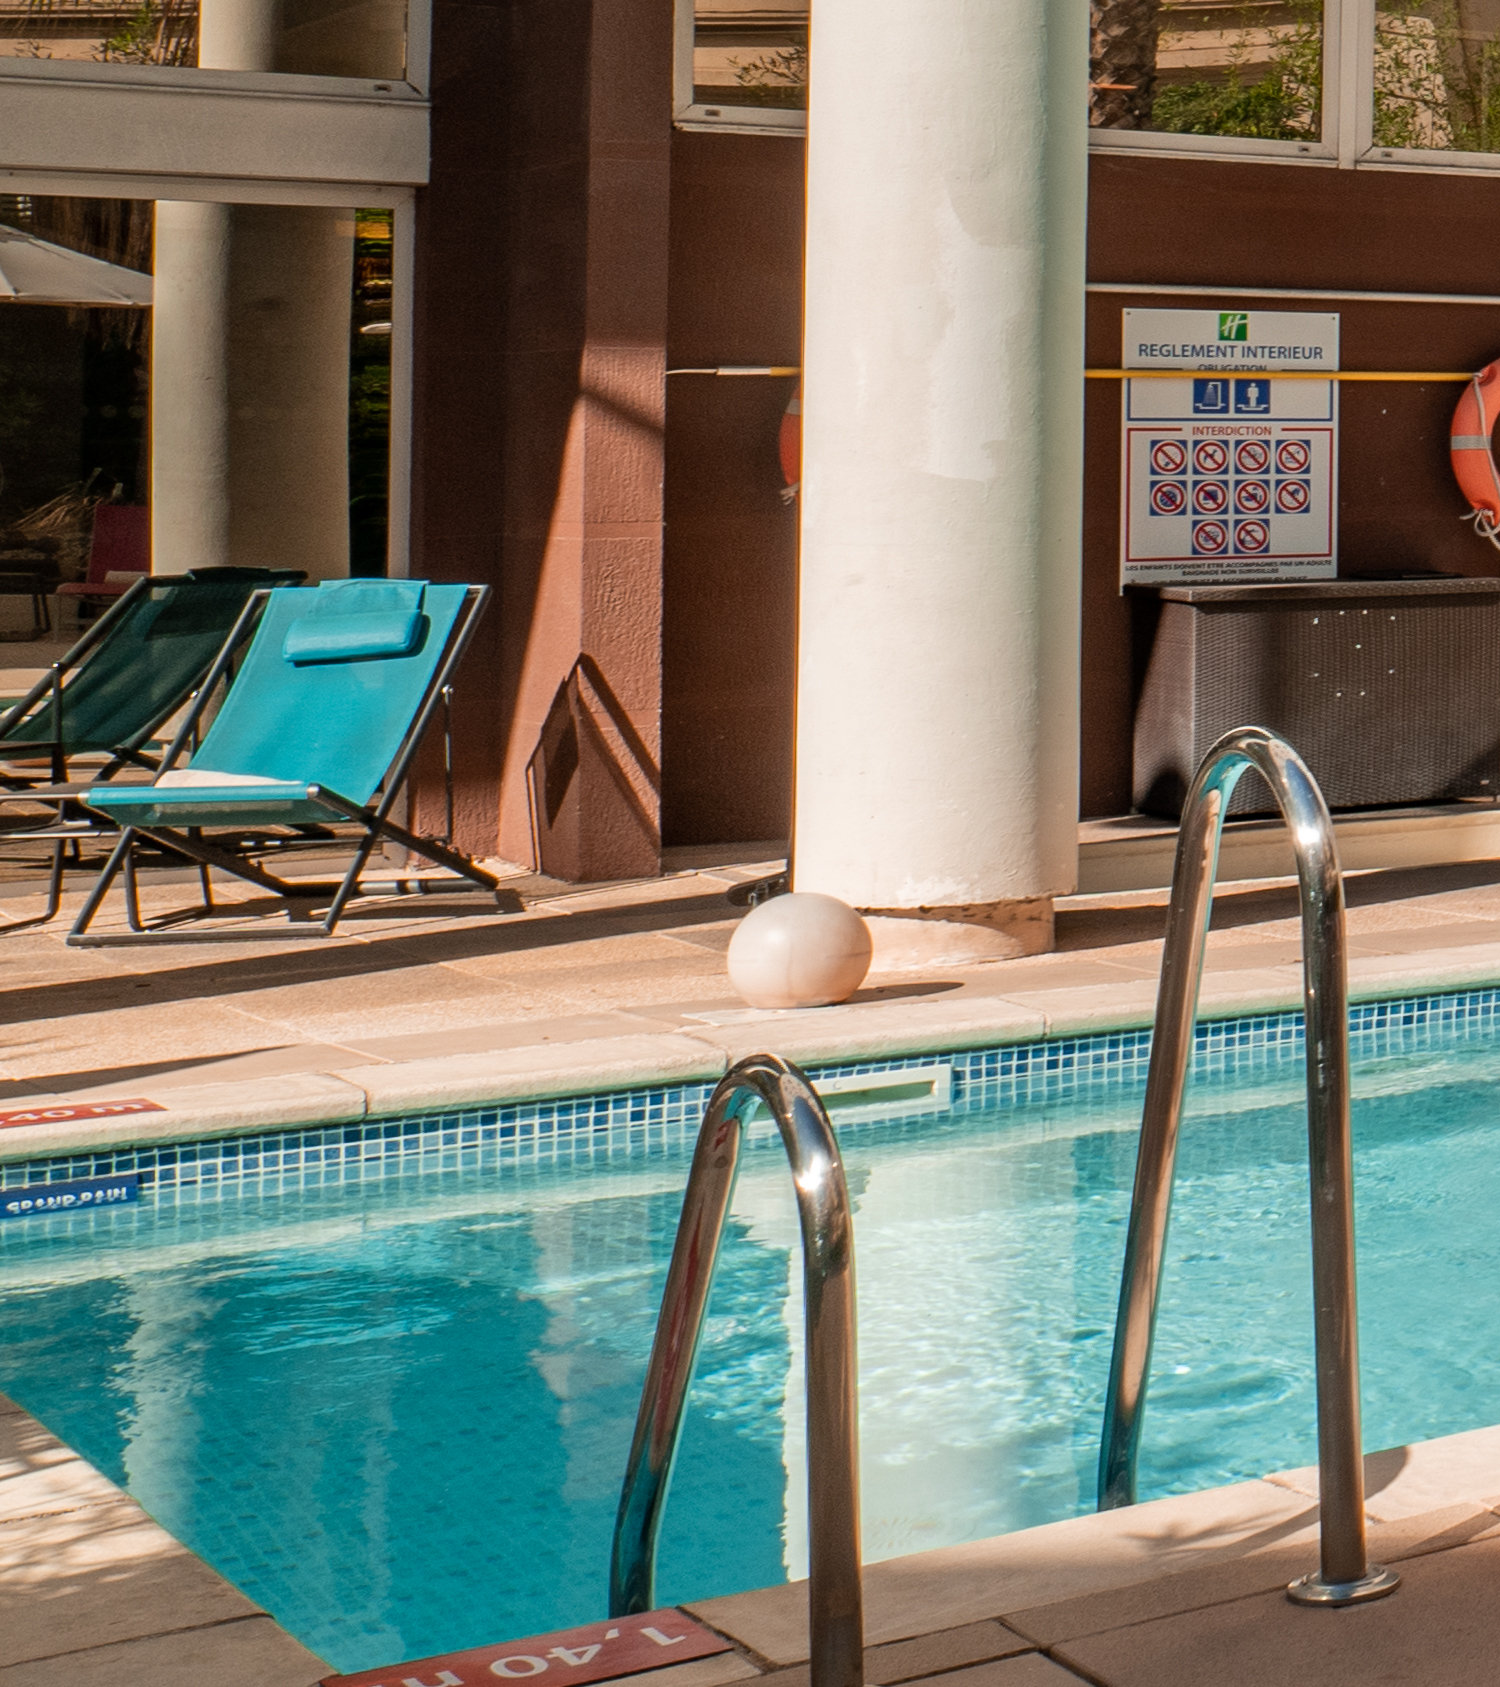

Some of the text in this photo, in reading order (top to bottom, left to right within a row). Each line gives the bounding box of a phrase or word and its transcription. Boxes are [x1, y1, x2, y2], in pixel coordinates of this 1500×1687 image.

[1138, 343, 1323, 360] REGLEMENT INTERIEUR
[1192, 426, 1272, 436] INTERDICTION
[489, 1626, 687, 1679] 1,40
